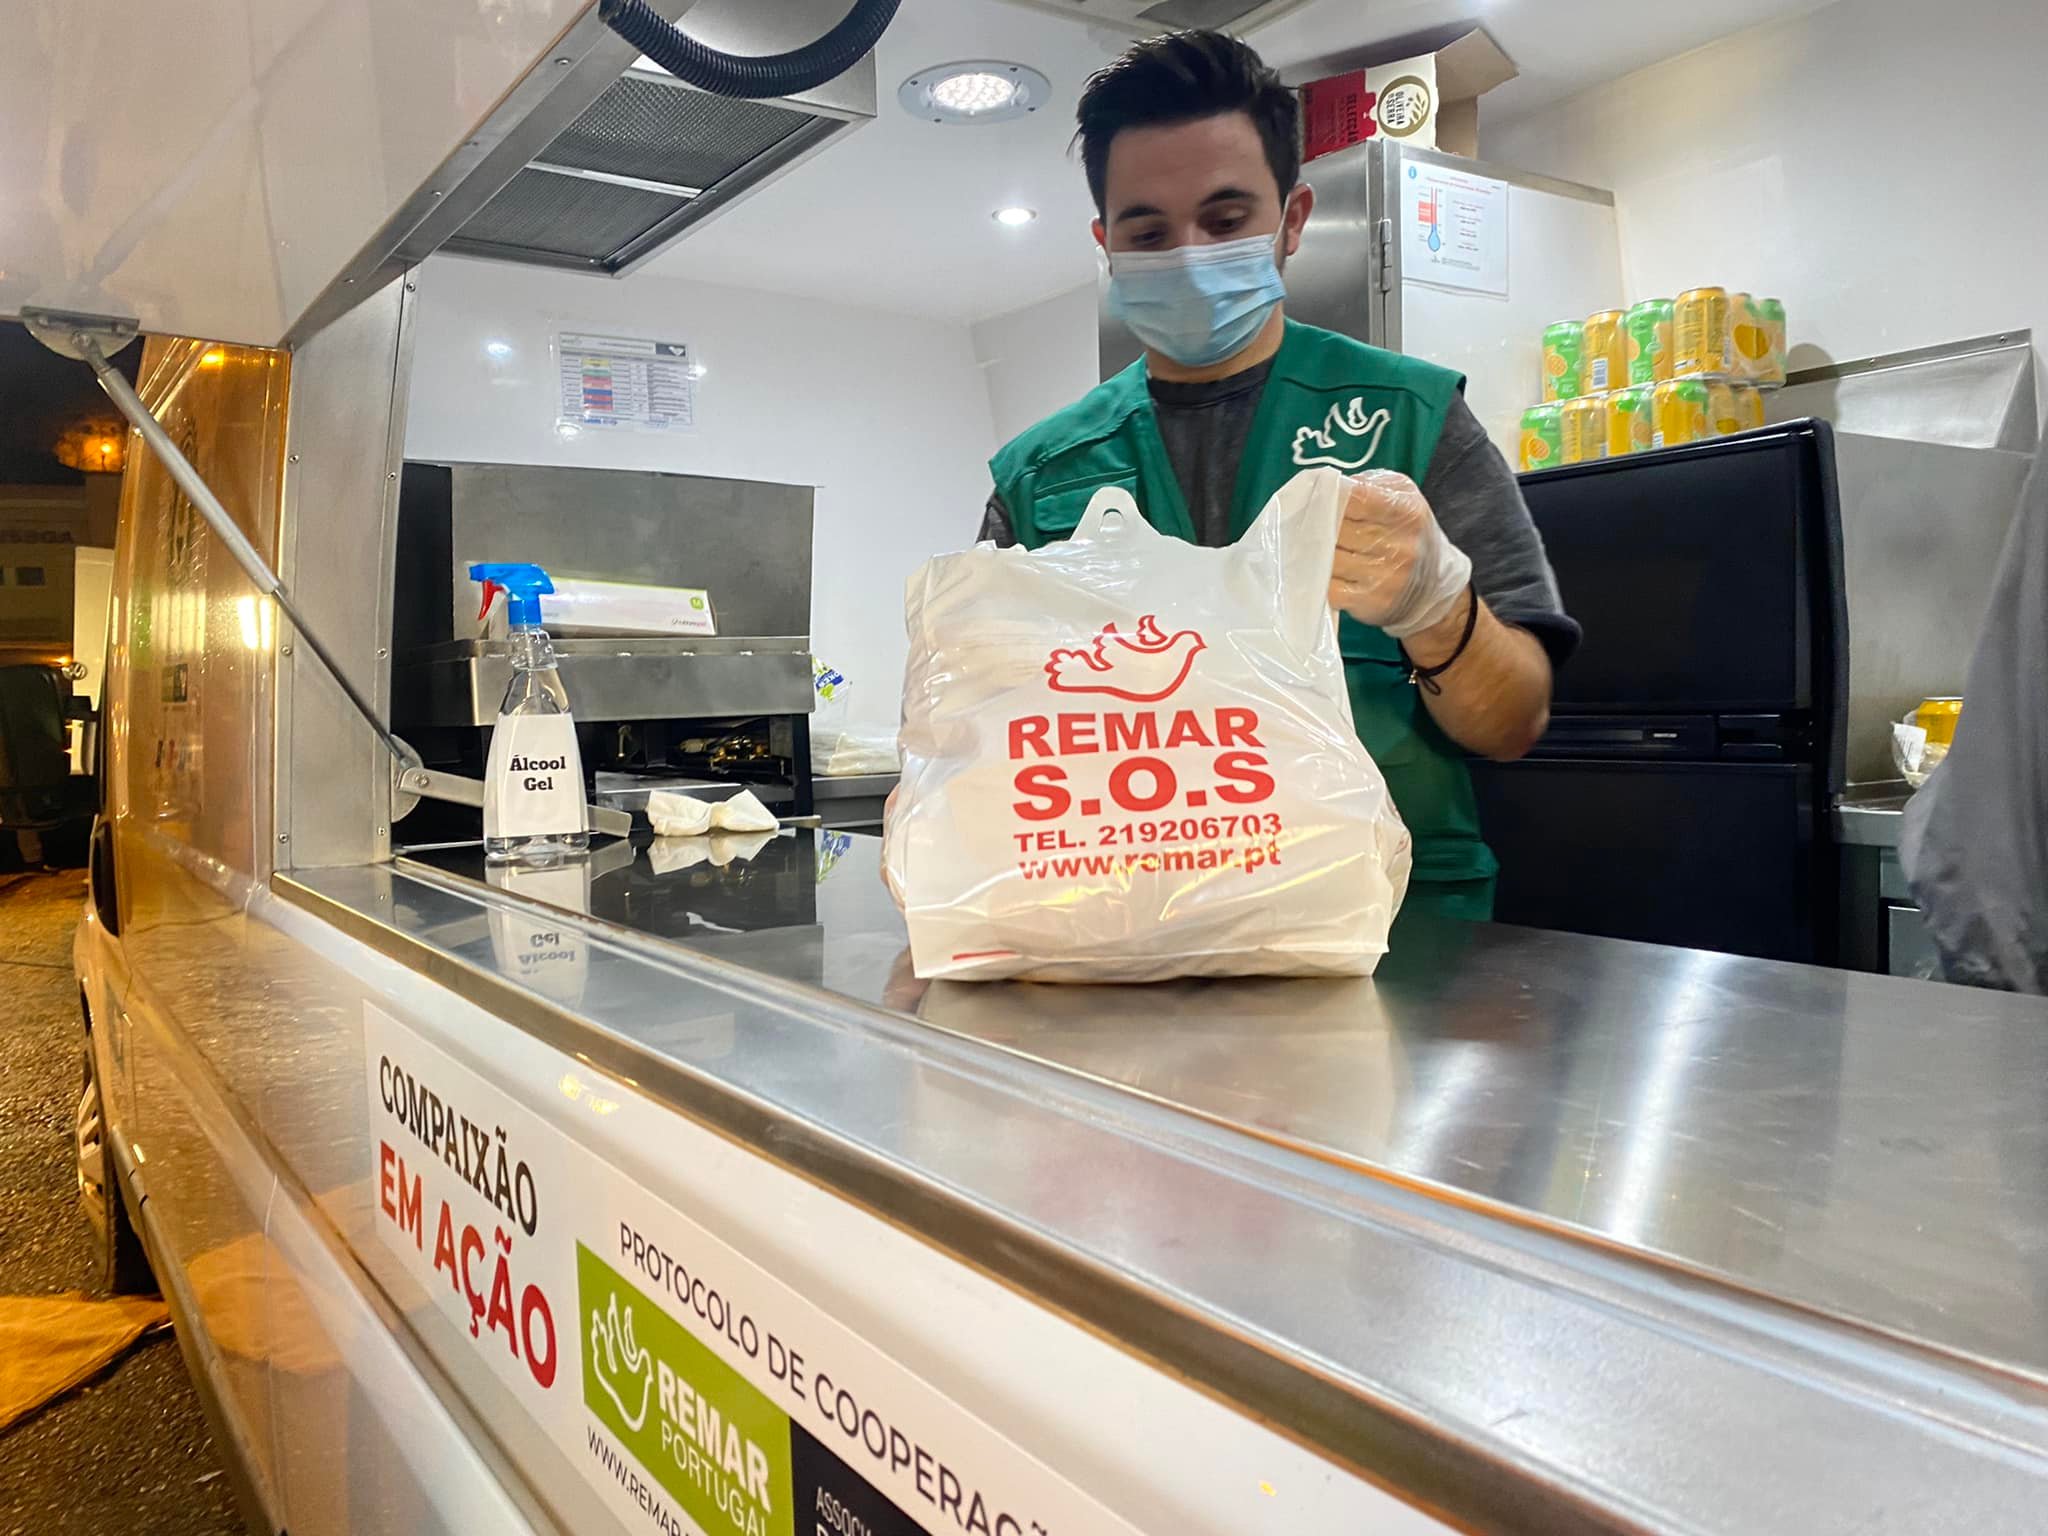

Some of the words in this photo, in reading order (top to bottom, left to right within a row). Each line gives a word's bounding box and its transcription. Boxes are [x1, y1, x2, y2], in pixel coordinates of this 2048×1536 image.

[1386, 98, 1397, 124] SERRA
[1394, 90, 1406, 125] OLIVEIRA
[1008, 707, 1267, 760] REMAR
[509, 754, 566, 771] Álcool
[523, 776, 553, 791] Gel
[1013, 752, 1276, 822] S.O.S
[1013, 830, 1087, 853] TEL.
[1098, 812, 1283, 847] 219206703
[1018, 840, 1281, 880] www.remar.pt
[380, 1055, 538, 1237] COMPAIXÃO
[380, 1140, 423, 1252] EM
[433, 1200, 557, 1389] AÇÃO
[620, 1222, 760, 1359] PROTOCOLO
[767, 1333, 806, 1400] DE
[815, 1372, 1047, 1536] COOPERA
[657, 1359, 772, 1514] REMAR
[587, 1426, 689, 1536] WWW.REMAR
